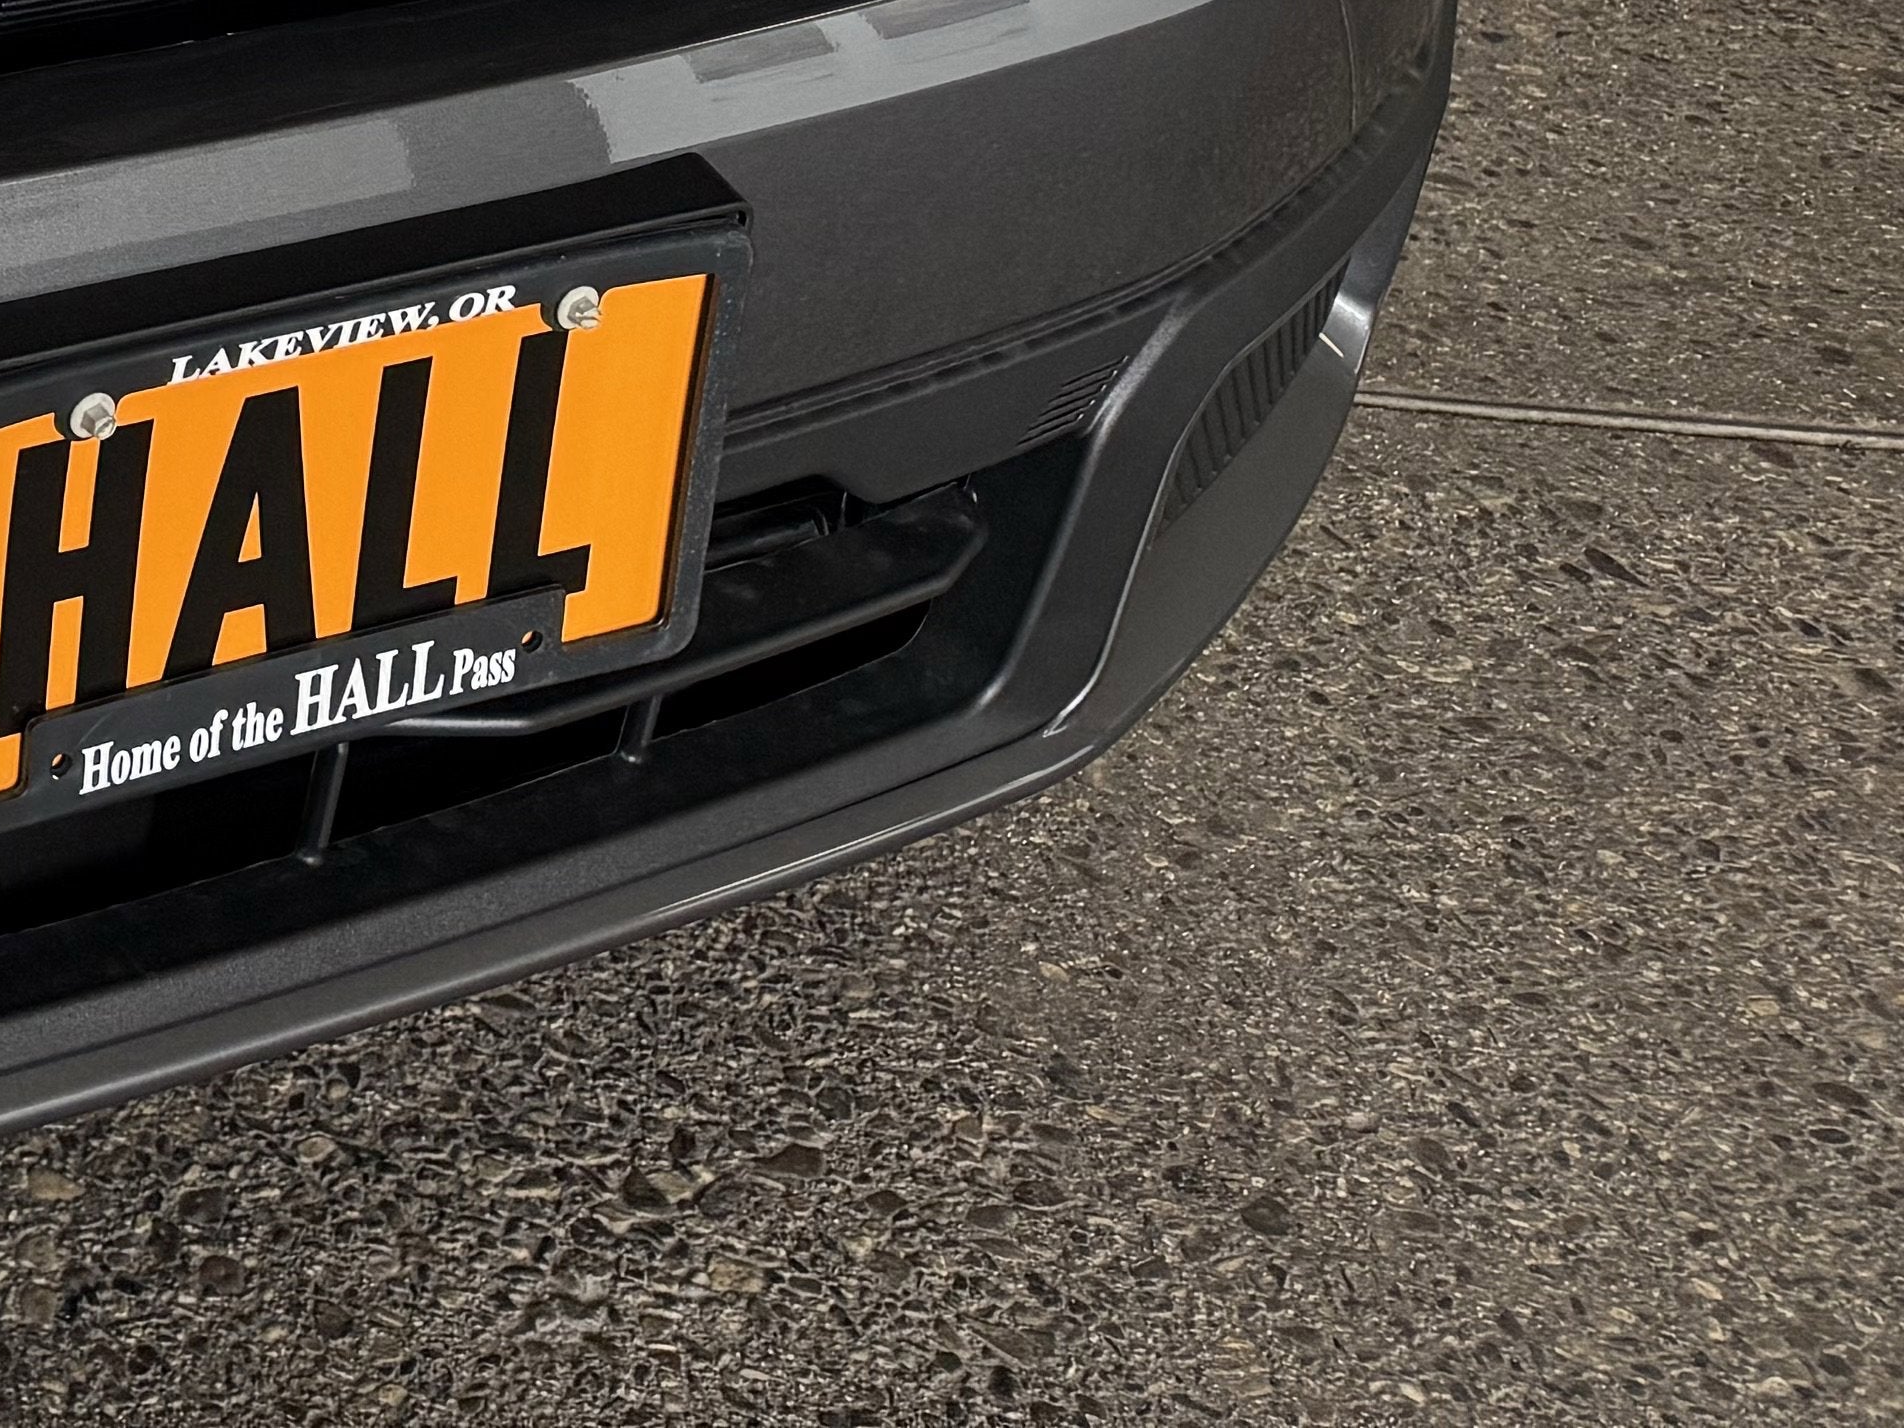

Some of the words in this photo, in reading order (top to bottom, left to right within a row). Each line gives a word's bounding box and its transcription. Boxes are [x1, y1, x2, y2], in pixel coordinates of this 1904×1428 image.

[166, 300, 441, 387] LAKEVIEW,
[447, 283, 517, 322] OR
[79, 740, 181, 796] Home
[189, 708, 229, 764] of
[231, 701, 283, 752] the
[289, 640, 445, 737] HALL
[449, 646, 517, 696] Pass
